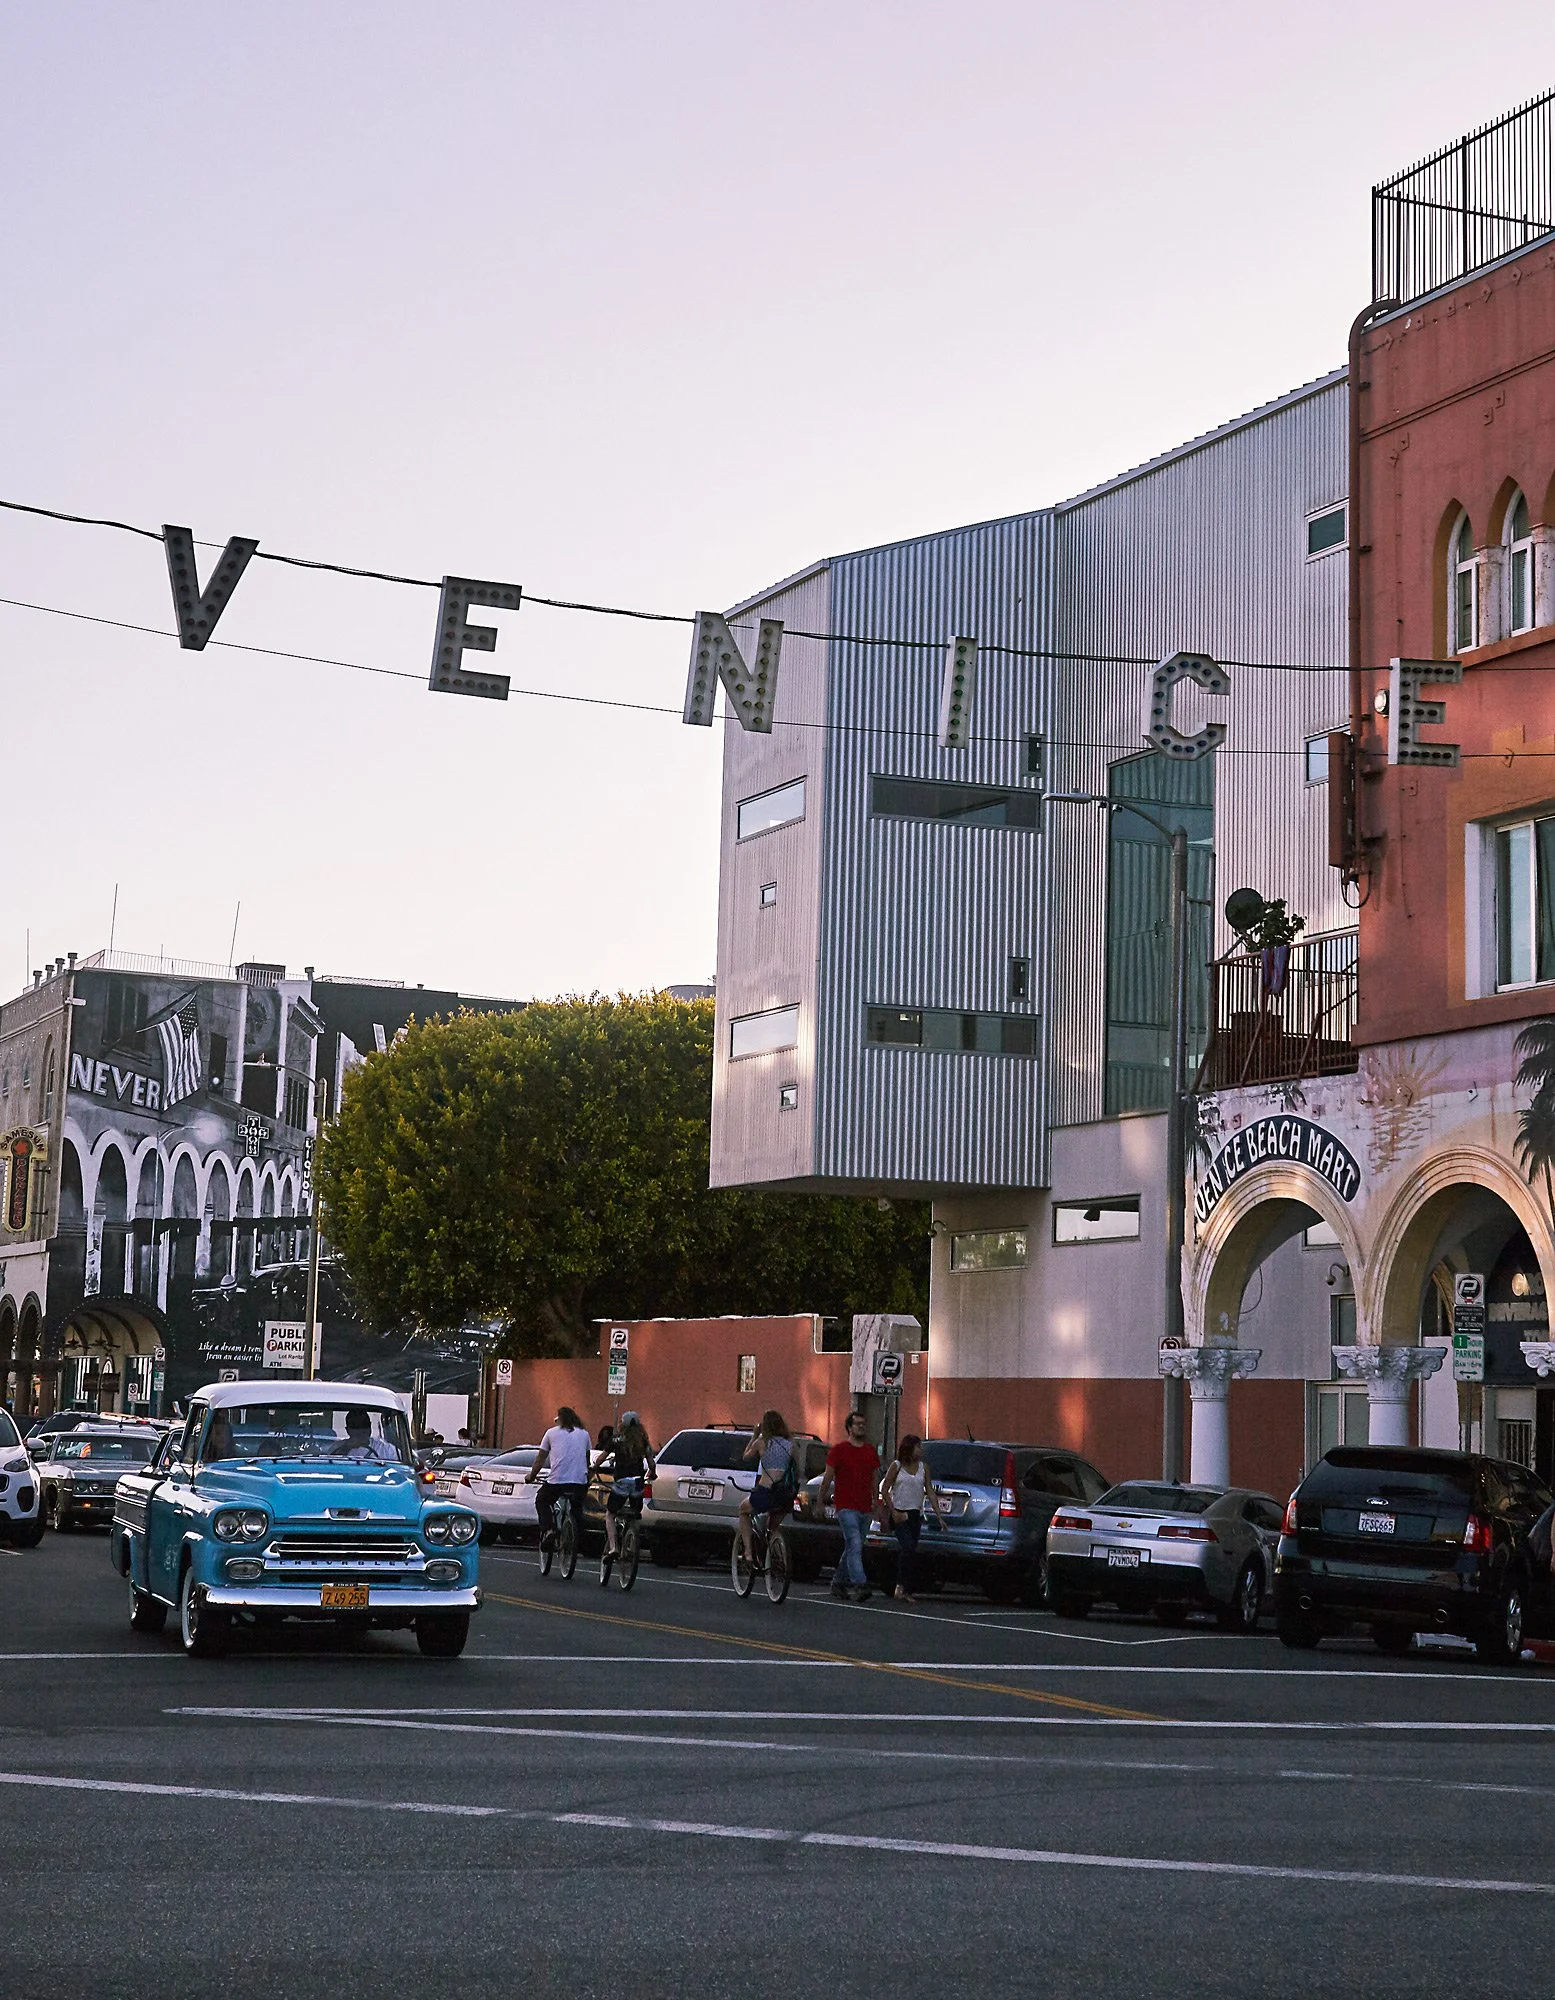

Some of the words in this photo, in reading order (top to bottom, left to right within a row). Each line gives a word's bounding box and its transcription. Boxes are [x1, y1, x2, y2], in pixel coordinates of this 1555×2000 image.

[162, 524, 1462, 767] VENICE
[70, 1053, 160, 1110] NEVER
[0, 1129, 45, 1152] SAMESUN
[1246, 1120, 1301, 1163] BEACH
[1307, 1129, 1356, 1198] MART
[271, 1328, 306, 1339] PUBLI
[220, 1341, 242, 1352] dream
[268, 1340, 317, 1352] PARKI
[204, 1351, 222, 1363] from
[1455, 1349, 1482, 1359] PARKING
[325, 1592, 332, 1605] Z
[334, 1592, 346, 1606] 49
